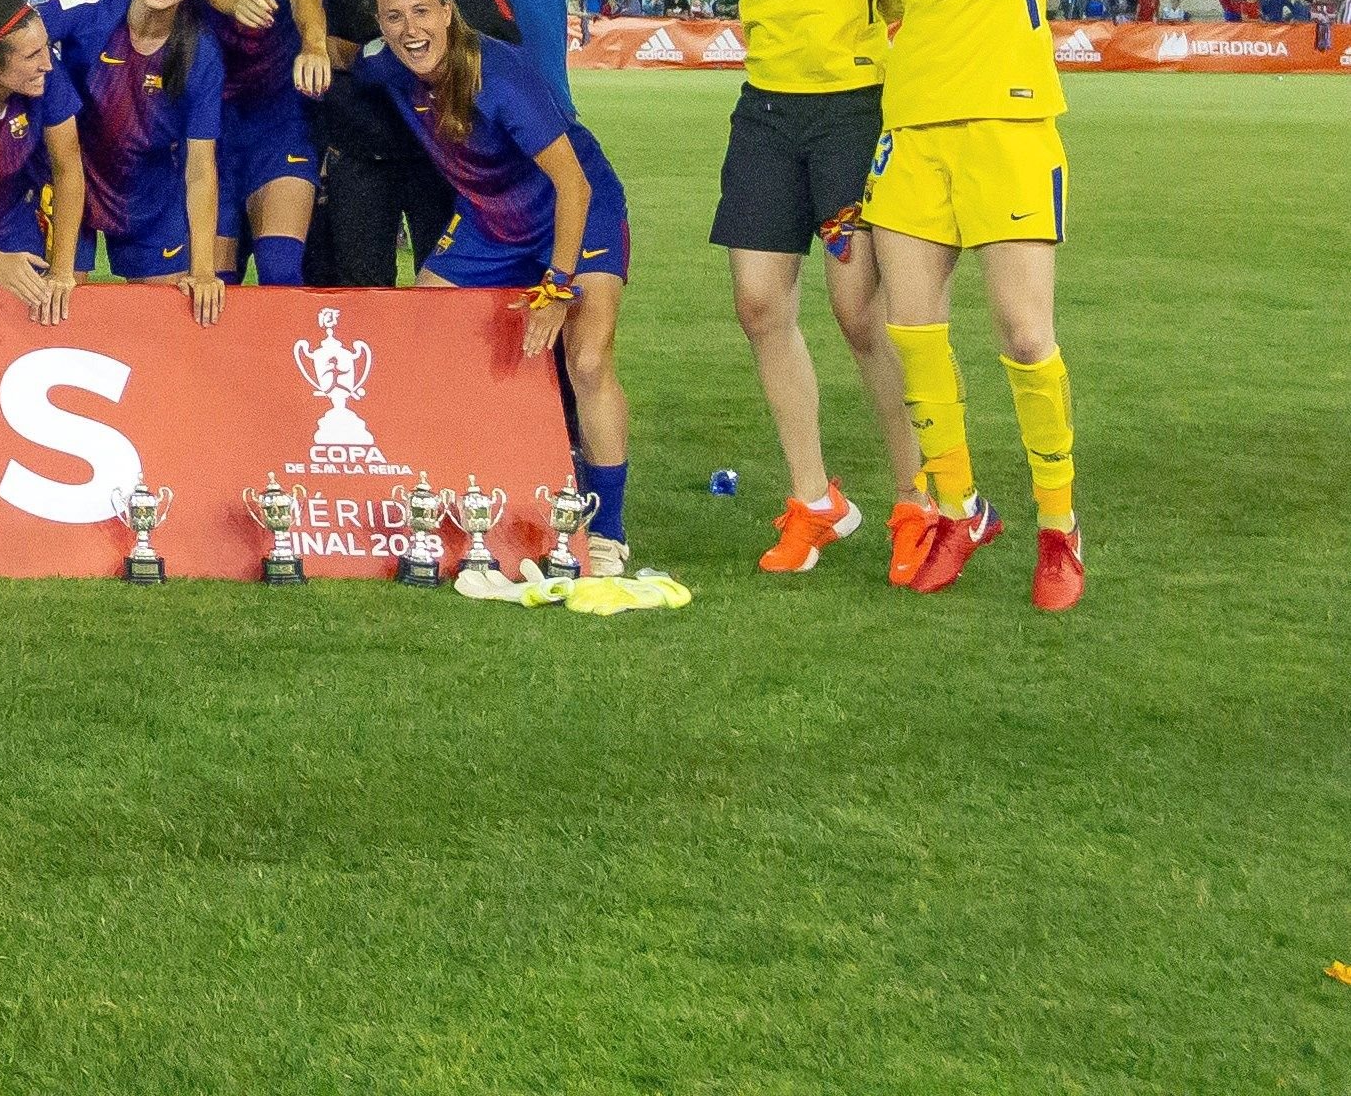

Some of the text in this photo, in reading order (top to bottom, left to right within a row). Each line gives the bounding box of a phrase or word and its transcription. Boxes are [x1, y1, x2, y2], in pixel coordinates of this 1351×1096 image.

[1191, 40, 1288, 56] IBERDROLA
[309, 445, 387, 464] COPA
[284, 462, 306, 474] DE
[310, 463, 341, 475] S.M.
[343, 463, 365, 475] LA
[289, 491, 409, 528] ÉRID
[284, 532, 365, 556] INAL
[370, 534, 445, 558] 208
